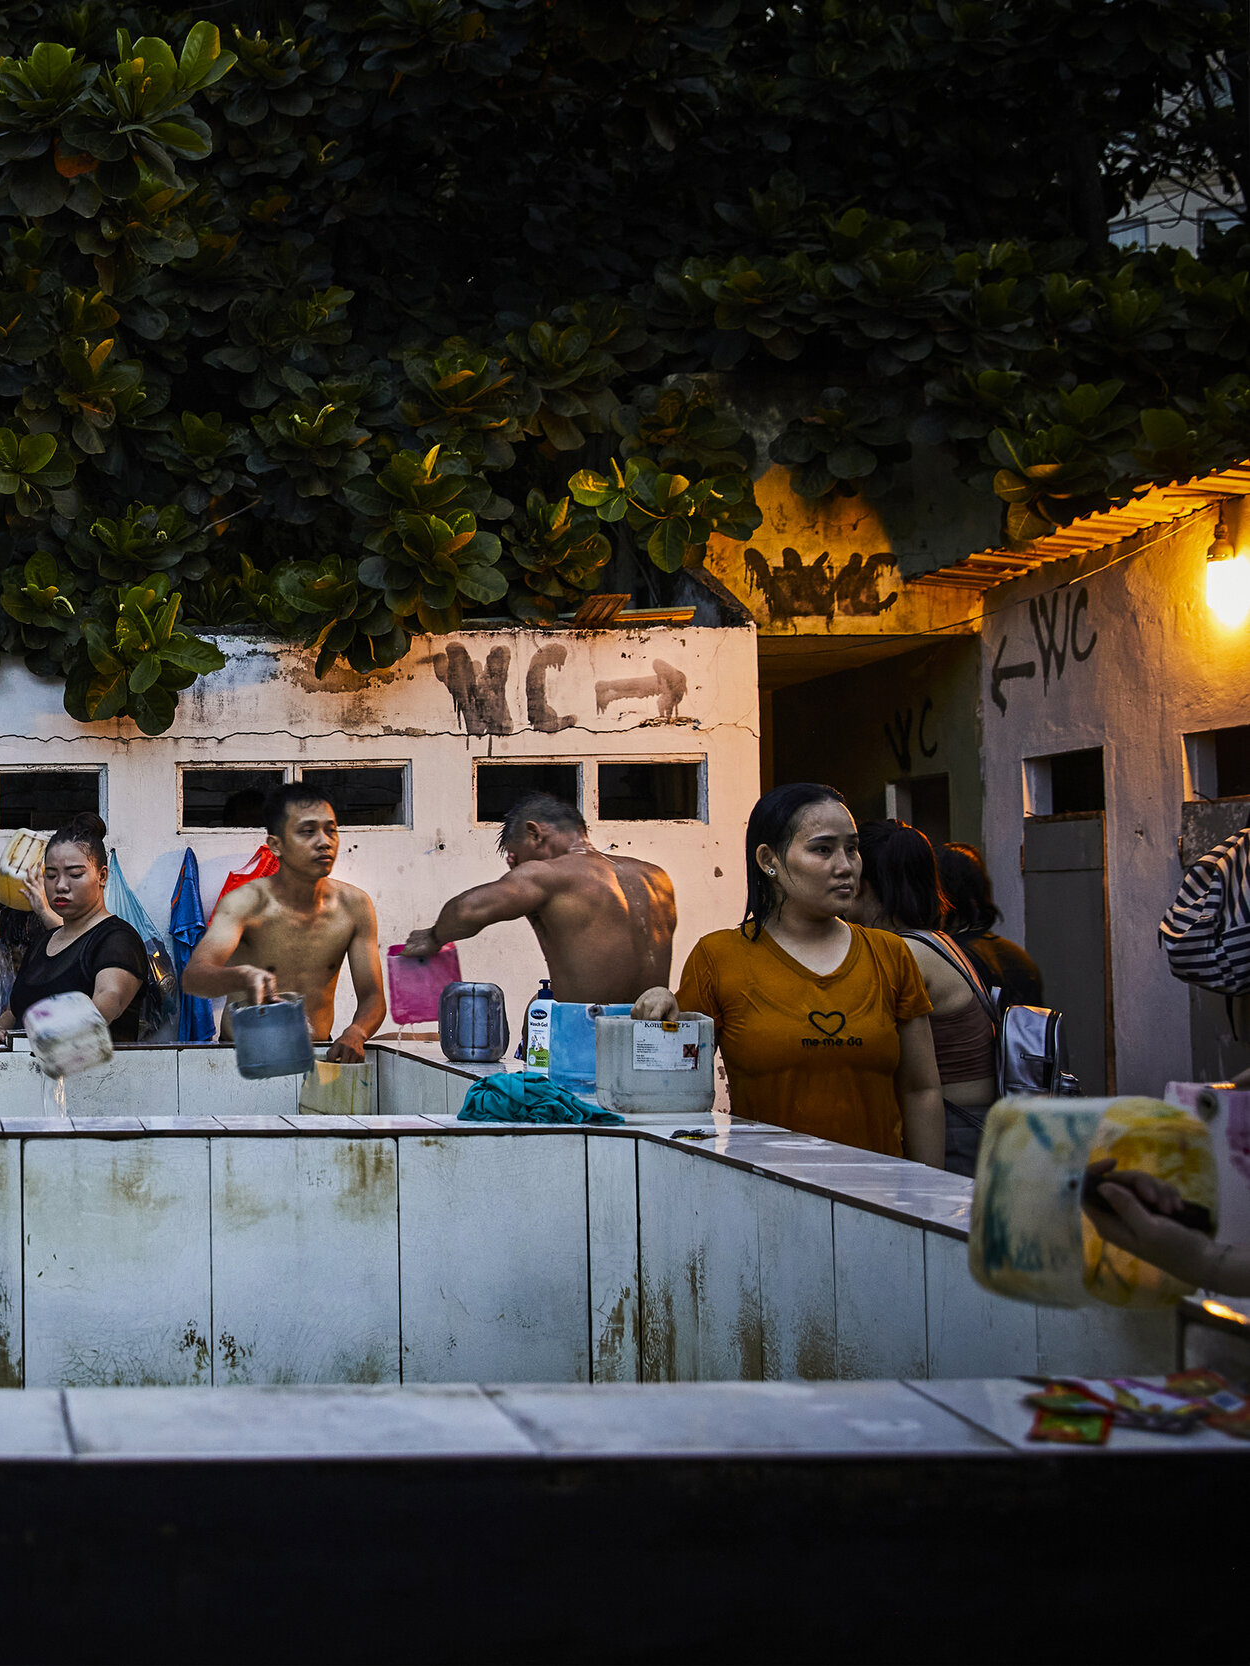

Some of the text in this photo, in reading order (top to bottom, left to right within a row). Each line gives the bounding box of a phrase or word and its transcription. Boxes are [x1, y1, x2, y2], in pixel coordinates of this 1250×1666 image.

[1029, 587, 1098, 684] WC
[432, 641, 579, 737] WC
[884, 697, 938, 772] WC
